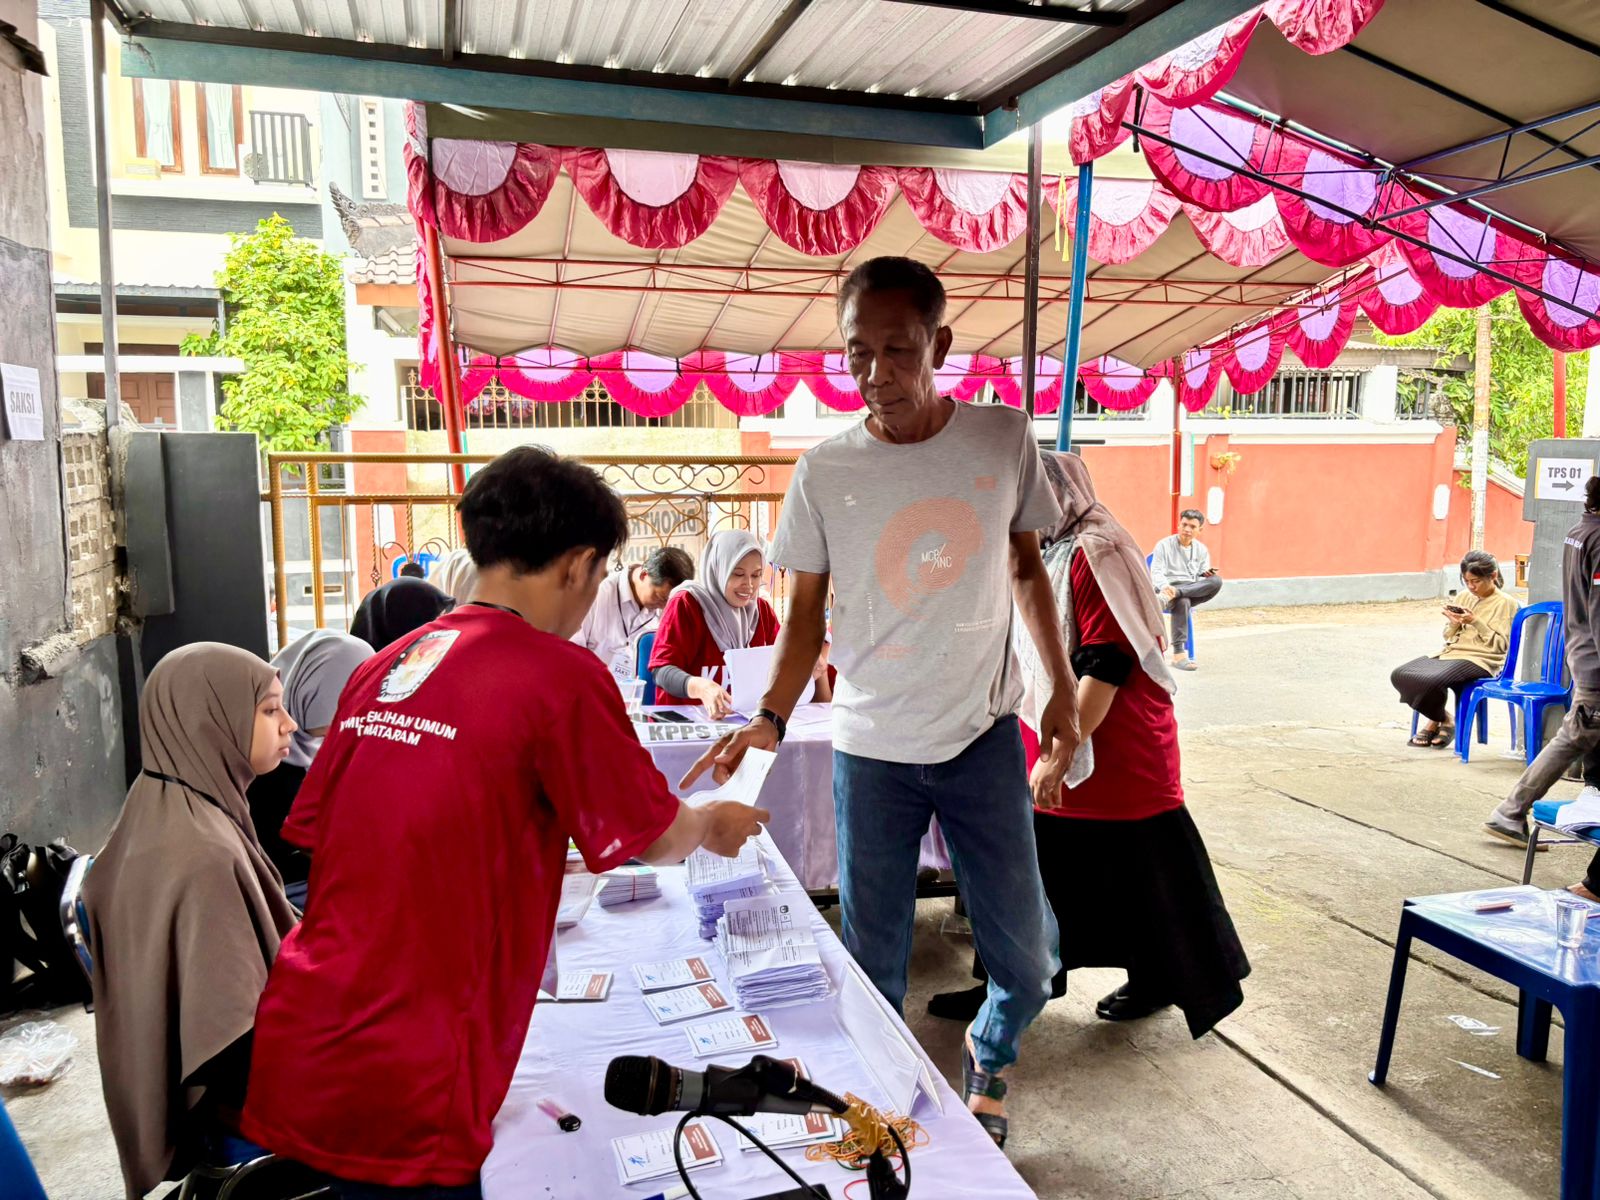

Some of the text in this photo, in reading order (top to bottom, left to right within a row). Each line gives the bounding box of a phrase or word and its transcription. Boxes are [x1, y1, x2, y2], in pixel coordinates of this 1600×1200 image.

[9, 390, 36, 414] SAKSI
[1547, 466, 1582, 479] TPS 01
[414, 717, 458, 740] UMUM
[648, 724, 711, 741] KPPS
